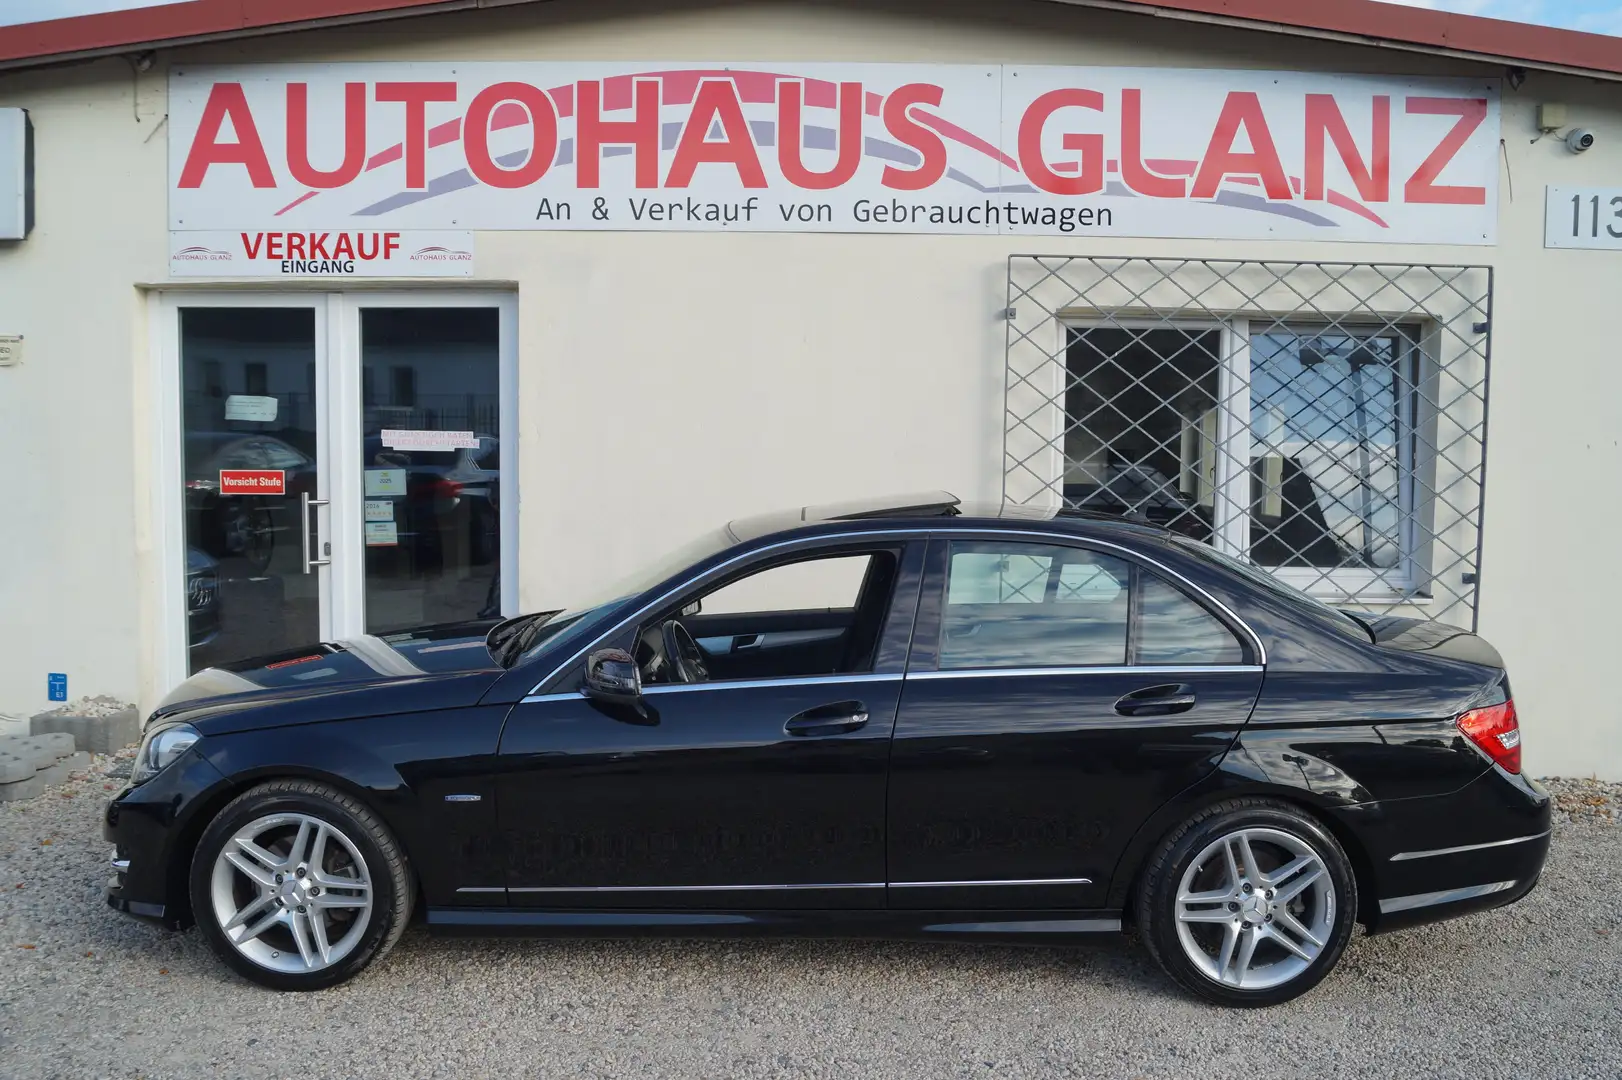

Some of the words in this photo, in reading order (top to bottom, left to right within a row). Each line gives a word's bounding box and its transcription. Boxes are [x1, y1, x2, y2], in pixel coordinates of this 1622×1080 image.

[177, 80, 947, 191] AUTOHAUS
[1017, 87, 1488, 205] GLANZ
[536, 198, 571, 221] An
[591, 197, 610, 221] &
[628, 197, 759, 223] Verkauf
[778, 203, 832, 222] von
[853, 199, 1113, 232] Gebrauchtwagen
[1571, 195, 1622, 239] 113
[240, 232, 400, 260] VERKAUF
[281, 260, 354, 273] EINGANG
[223, 477, 258, 487] Vorsicht
[259, 477, 282, 487] Stufe
